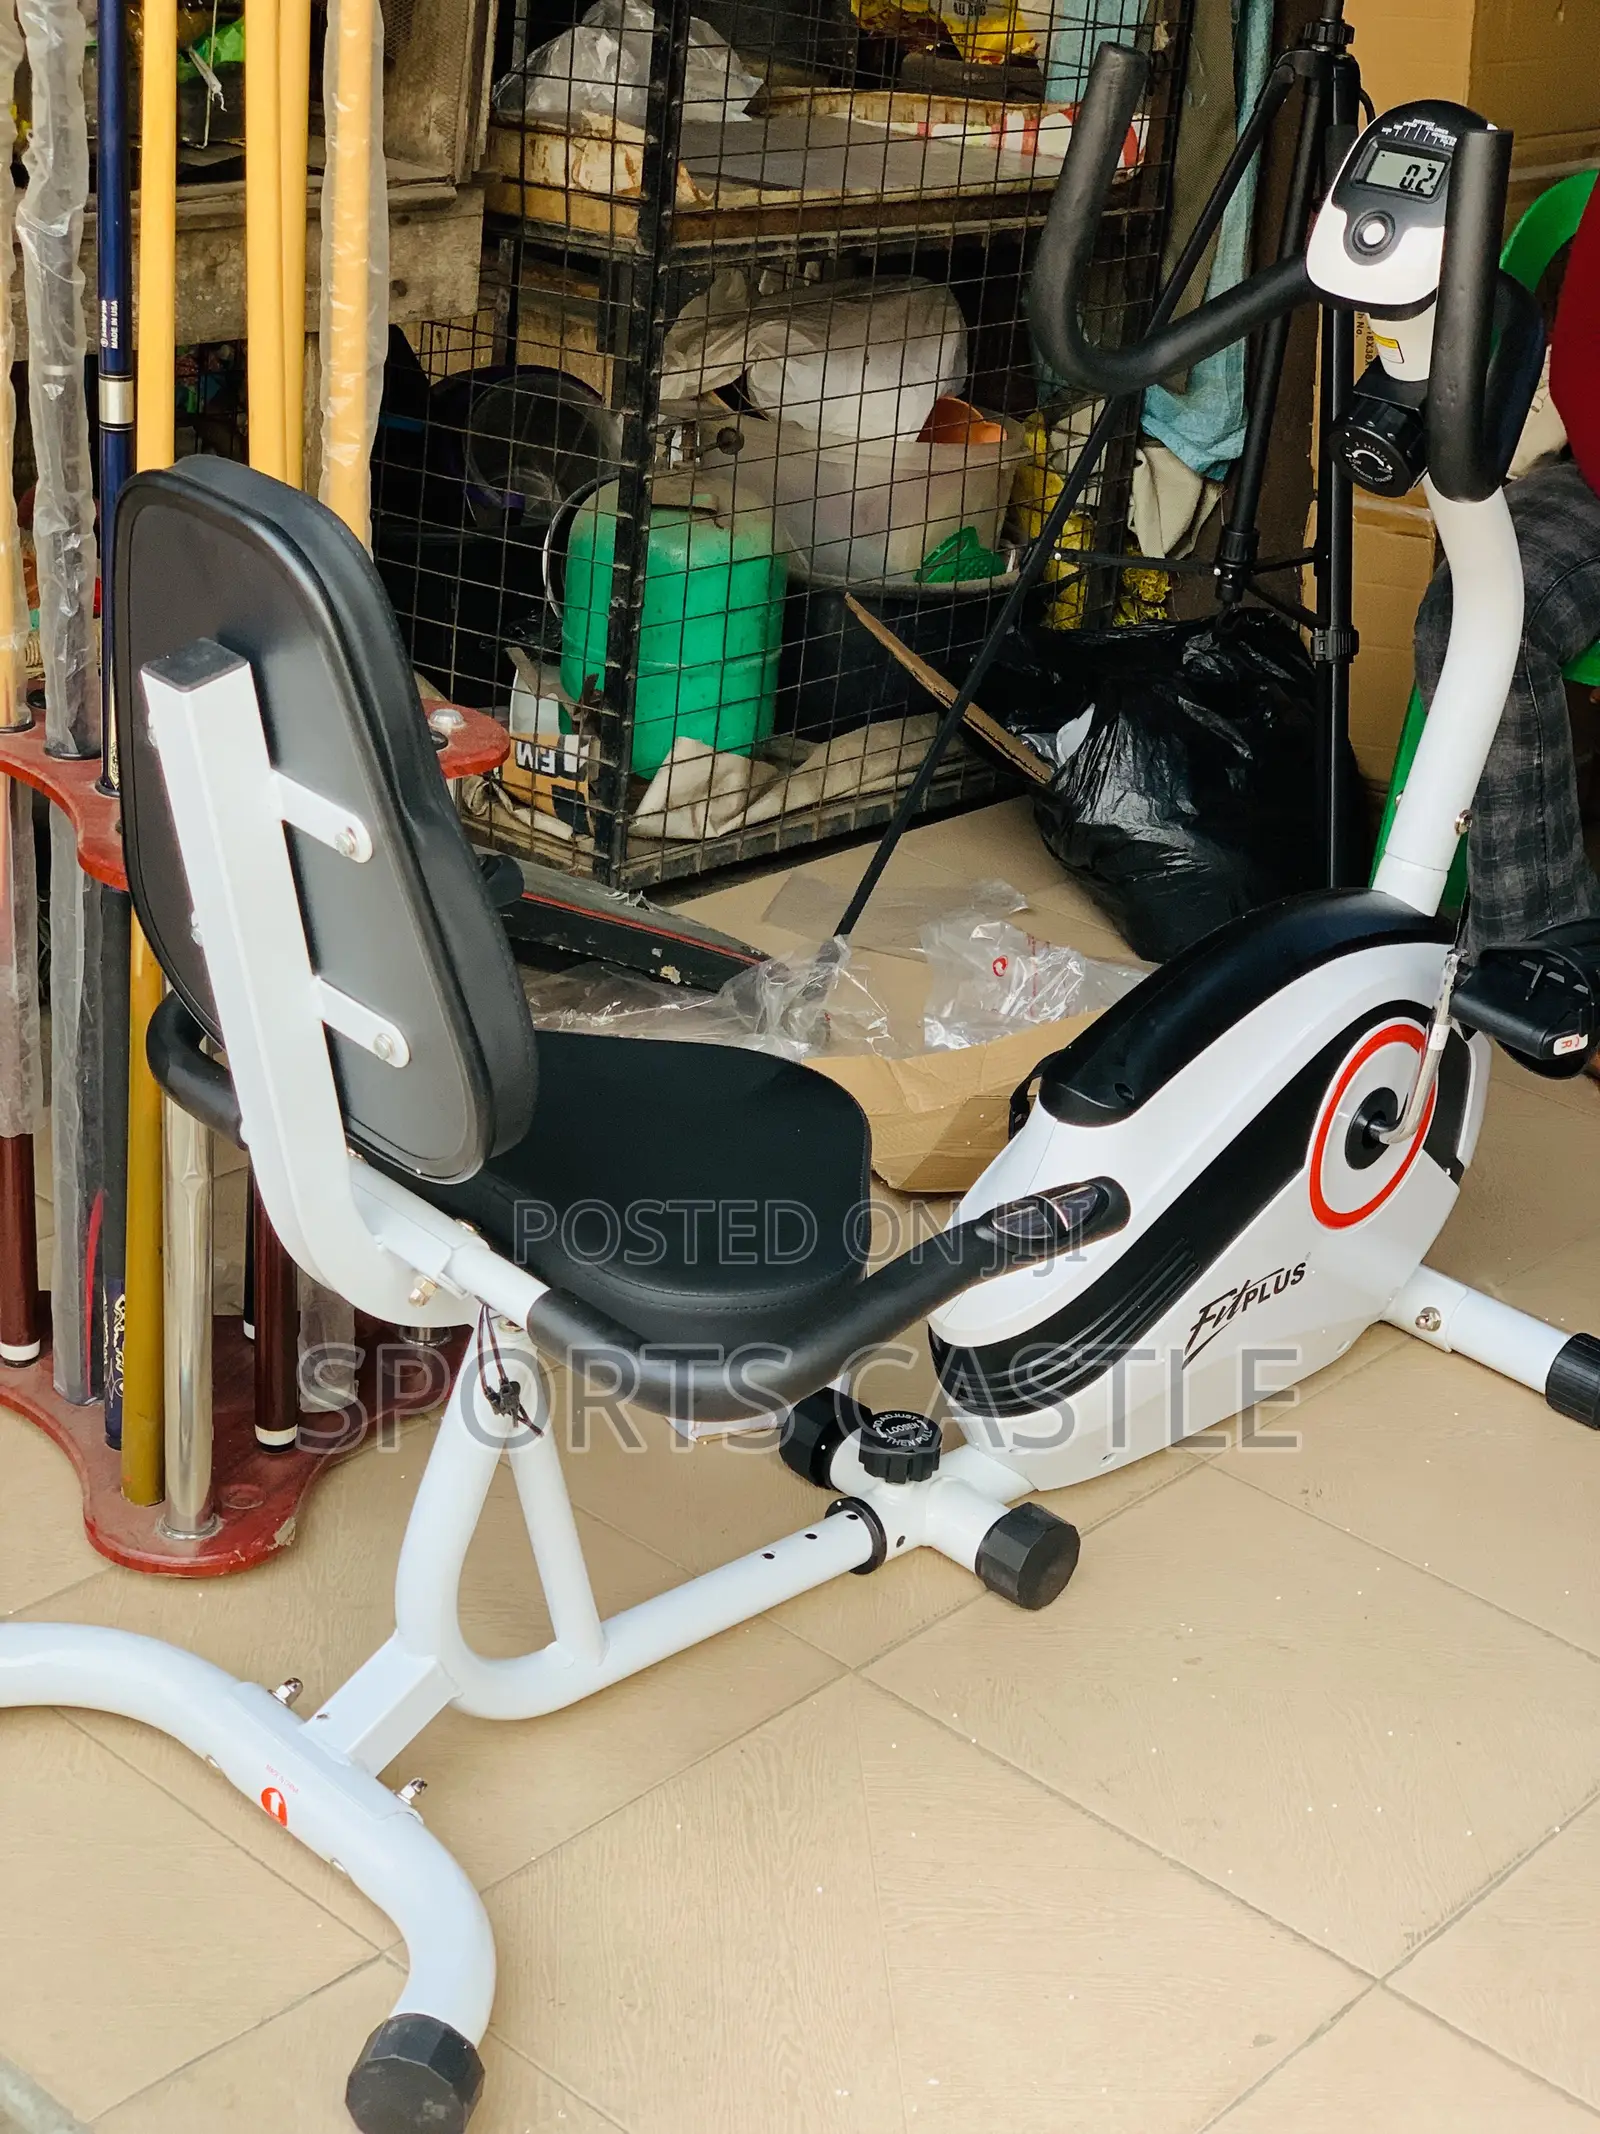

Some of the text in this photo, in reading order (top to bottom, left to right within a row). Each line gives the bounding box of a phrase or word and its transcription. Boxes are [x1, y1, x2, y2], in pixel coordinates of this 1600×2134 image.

[1399, 164, 1437, 193] 0.2
[110, 300, 118, 349] MADE IN USA
[880, 1413, 919, 1422] ADJUST
[885, 1422, 920, 1435] LOOSEN
[886, 1429, 933, 1447] THEN PULL
